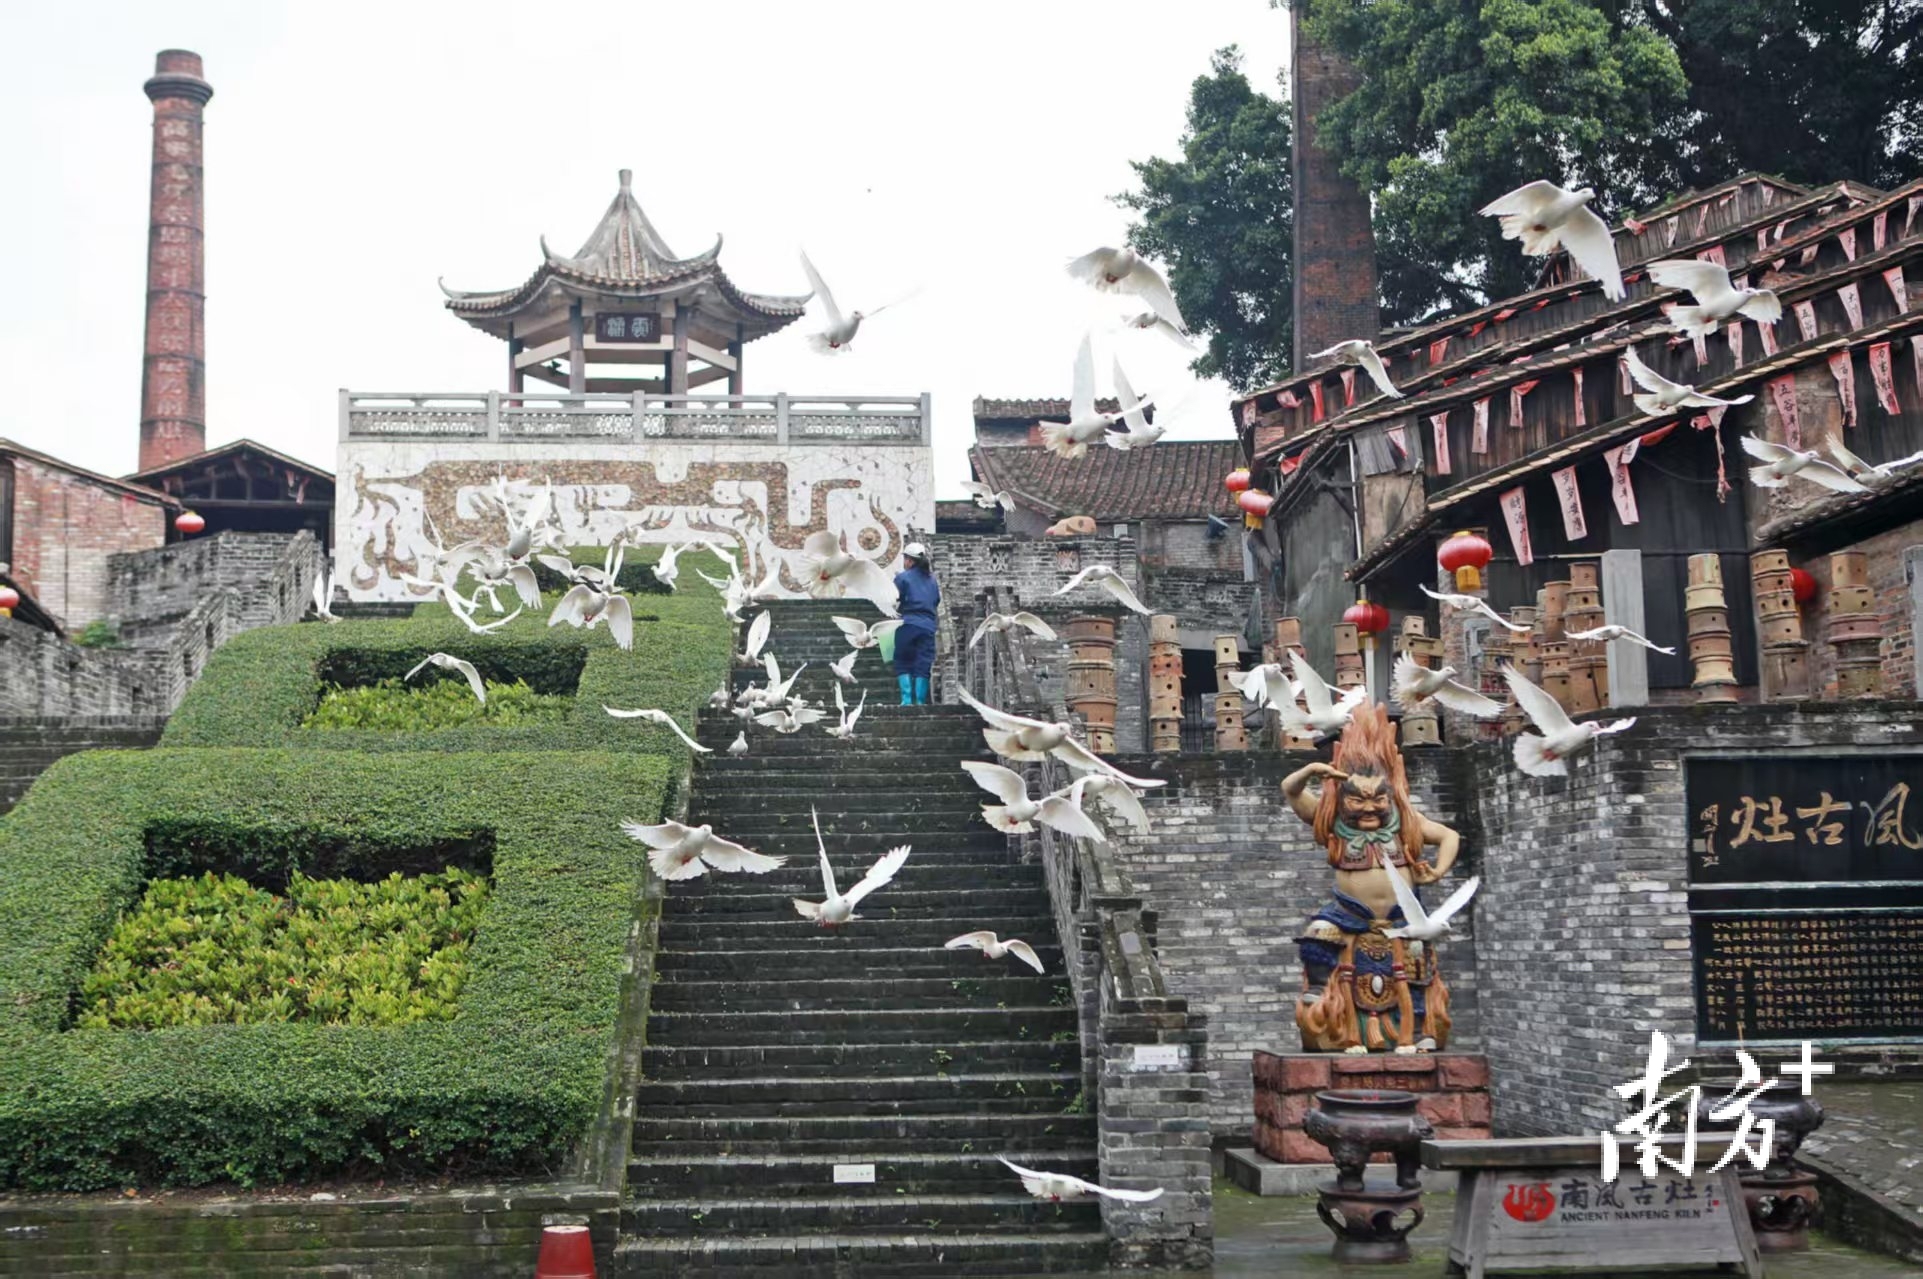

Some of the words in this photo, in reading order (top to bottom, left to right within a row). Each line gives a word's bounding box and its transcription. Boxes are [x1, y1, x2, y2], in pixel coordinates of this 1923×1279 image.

[1561, 1211, 1609, 1223] ANCIENT
[1615, 1209, 1670, 1221] NANFENG
[1674, 1209, 1701, 1219] KILN
